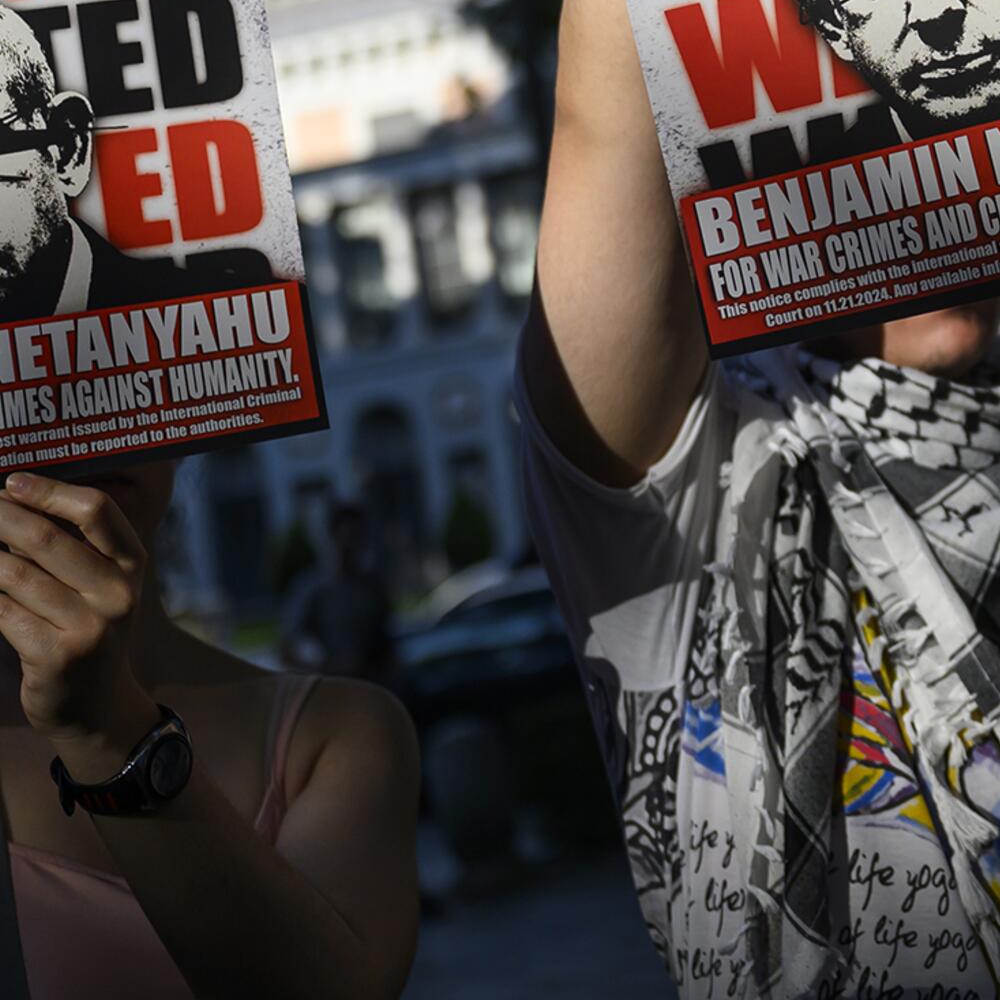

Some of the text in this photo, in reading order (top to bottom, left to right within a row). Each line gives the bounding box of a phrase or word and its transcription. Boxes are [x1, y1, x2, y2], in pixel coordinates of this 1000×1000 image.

[694, 134, 980, 257] BENJAMIN
[709, 256, 763, 301] FOR
[760, 240, 825, 289] WAR
[824, 215, 925, 275] CRIMES
[924, 203, 979, 250] AND
[717, 303, 748, 320] This
[749, 292, 792, 313] notice
[794, 278, 856, 305] complies
[855, 269, 888, 287] with
[887, 264, 911, 279] the
[911, 241, 999, 275] international
[765, 309, 805, 328] Court
[804, 304, 823, 319] on
[823, 287, 893, 315] 11.21.2024.
[893, 281, 918, 299] Any
[919, 266, 981, 292] available
[19, 428, 70, 446] warrant
[72, 419, 117, 438] issued
[117, 416, 135, 434] by
[136, 411, 159, 426] the
[160, 394, 247, 423] International
[246, 385, 302, 408] Criminal
[60, 369, 165, 421] AGAINST
[167, 349, 300, 402] HUMANITY.
[35, 446, 70, 462] must
[71, 441, 88, 455] be
[90, 430, 148, 454] reported
[149, 428, 164, 443] to
[165, 423, 189, 439] the
[189, 411, 265, 436] authorities.
[849, 849, 894, 910] life
[838, 915, 979, 972] of life yoga
